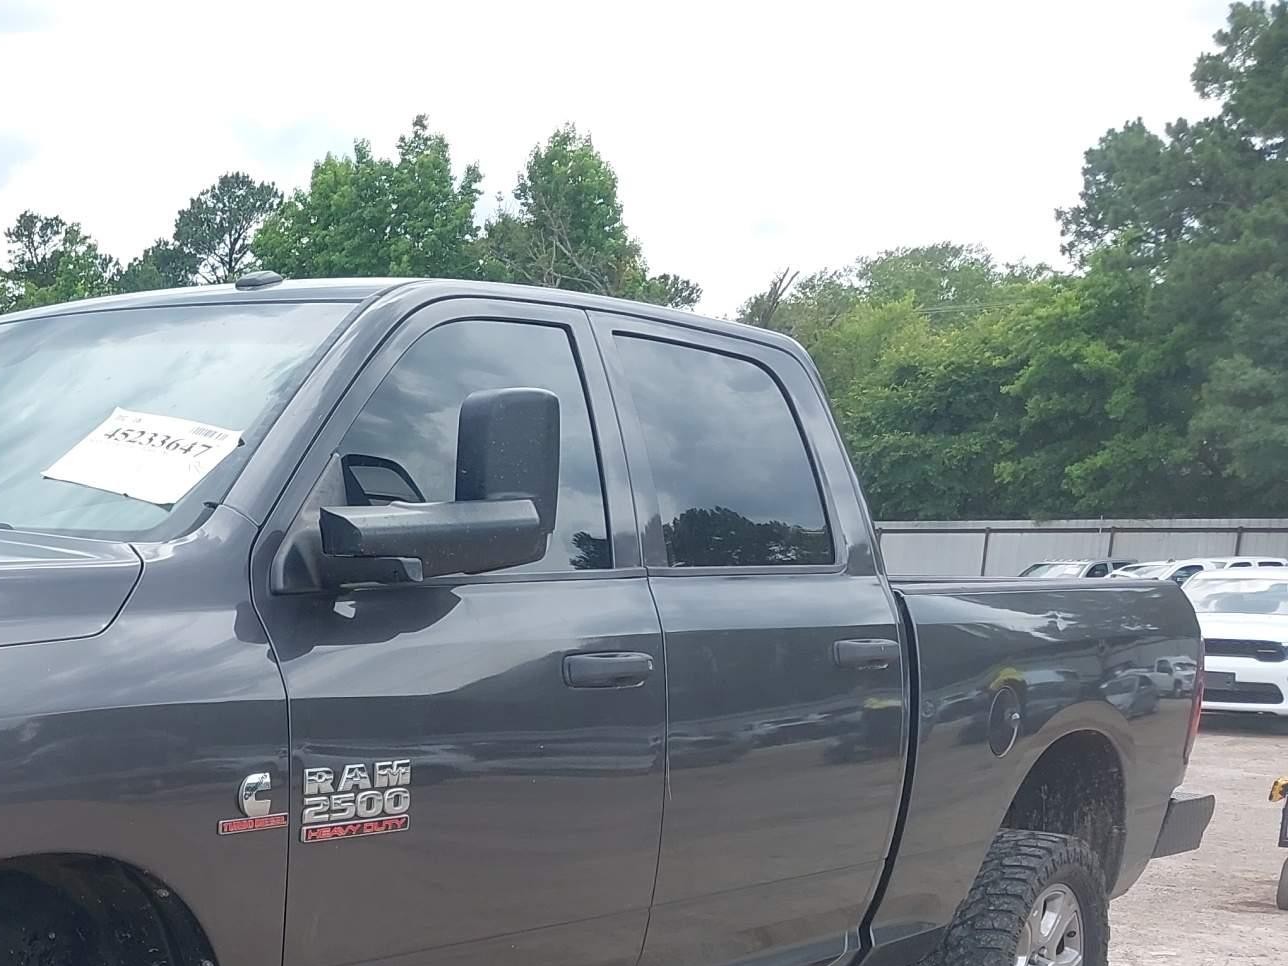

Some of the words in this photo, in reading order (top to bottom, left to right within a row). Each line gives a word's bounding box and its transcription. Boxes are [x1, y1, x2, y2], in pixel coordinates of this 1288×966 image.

[103, 426, 213, 458] 45233647
[303, 759, 412, 796] RAM
[301, 787, 412, 825] 2500
[307, 823, 362, 841] HEAVY
[362, 816, 408, 834] DUTY
